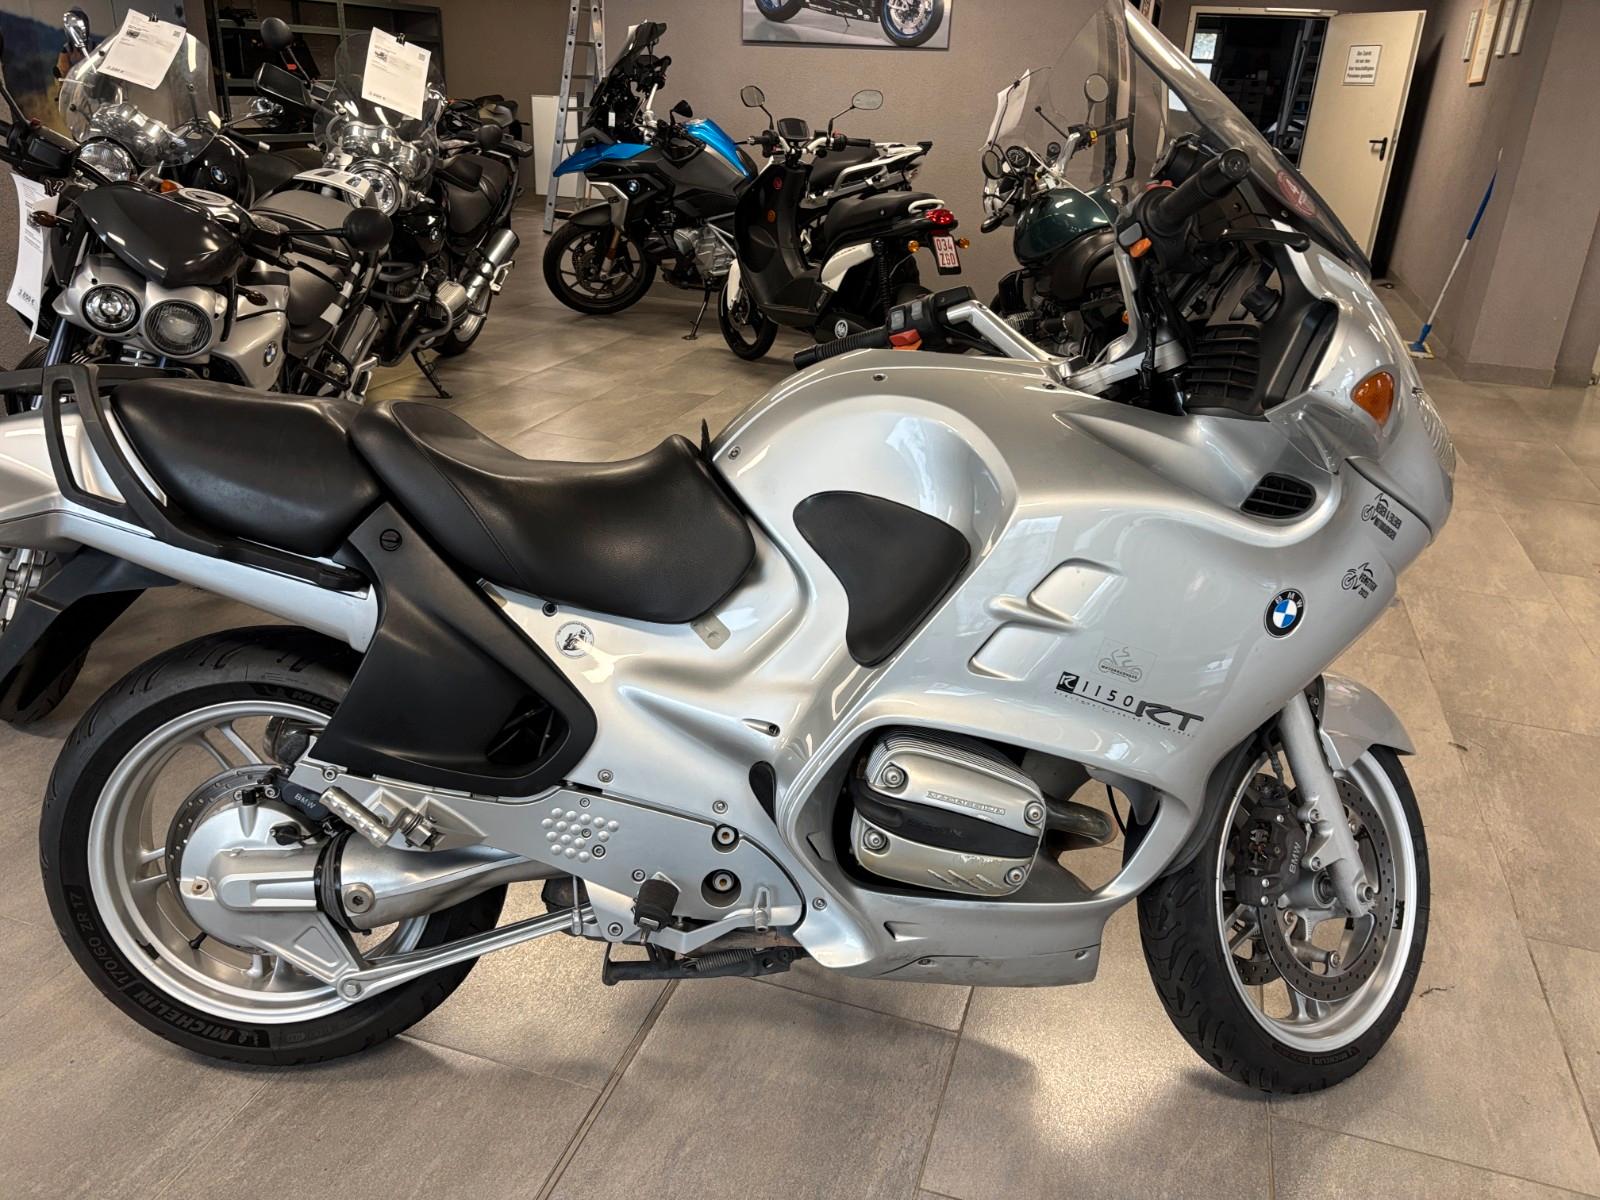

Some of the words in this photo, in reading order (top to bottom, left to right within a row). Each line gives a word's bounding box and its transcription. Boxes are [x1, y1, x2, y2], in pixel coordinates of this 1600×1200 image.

[936, 238, 953, 251] 034
[1081, 680, 1134, 707] 1150
[294, 793, 316, 808] BMW
[1289, 841, 1301, 874] BMW
[89, 937, 129, 984] 170/60
[134, 988, 234, 1041] MICHELIN
